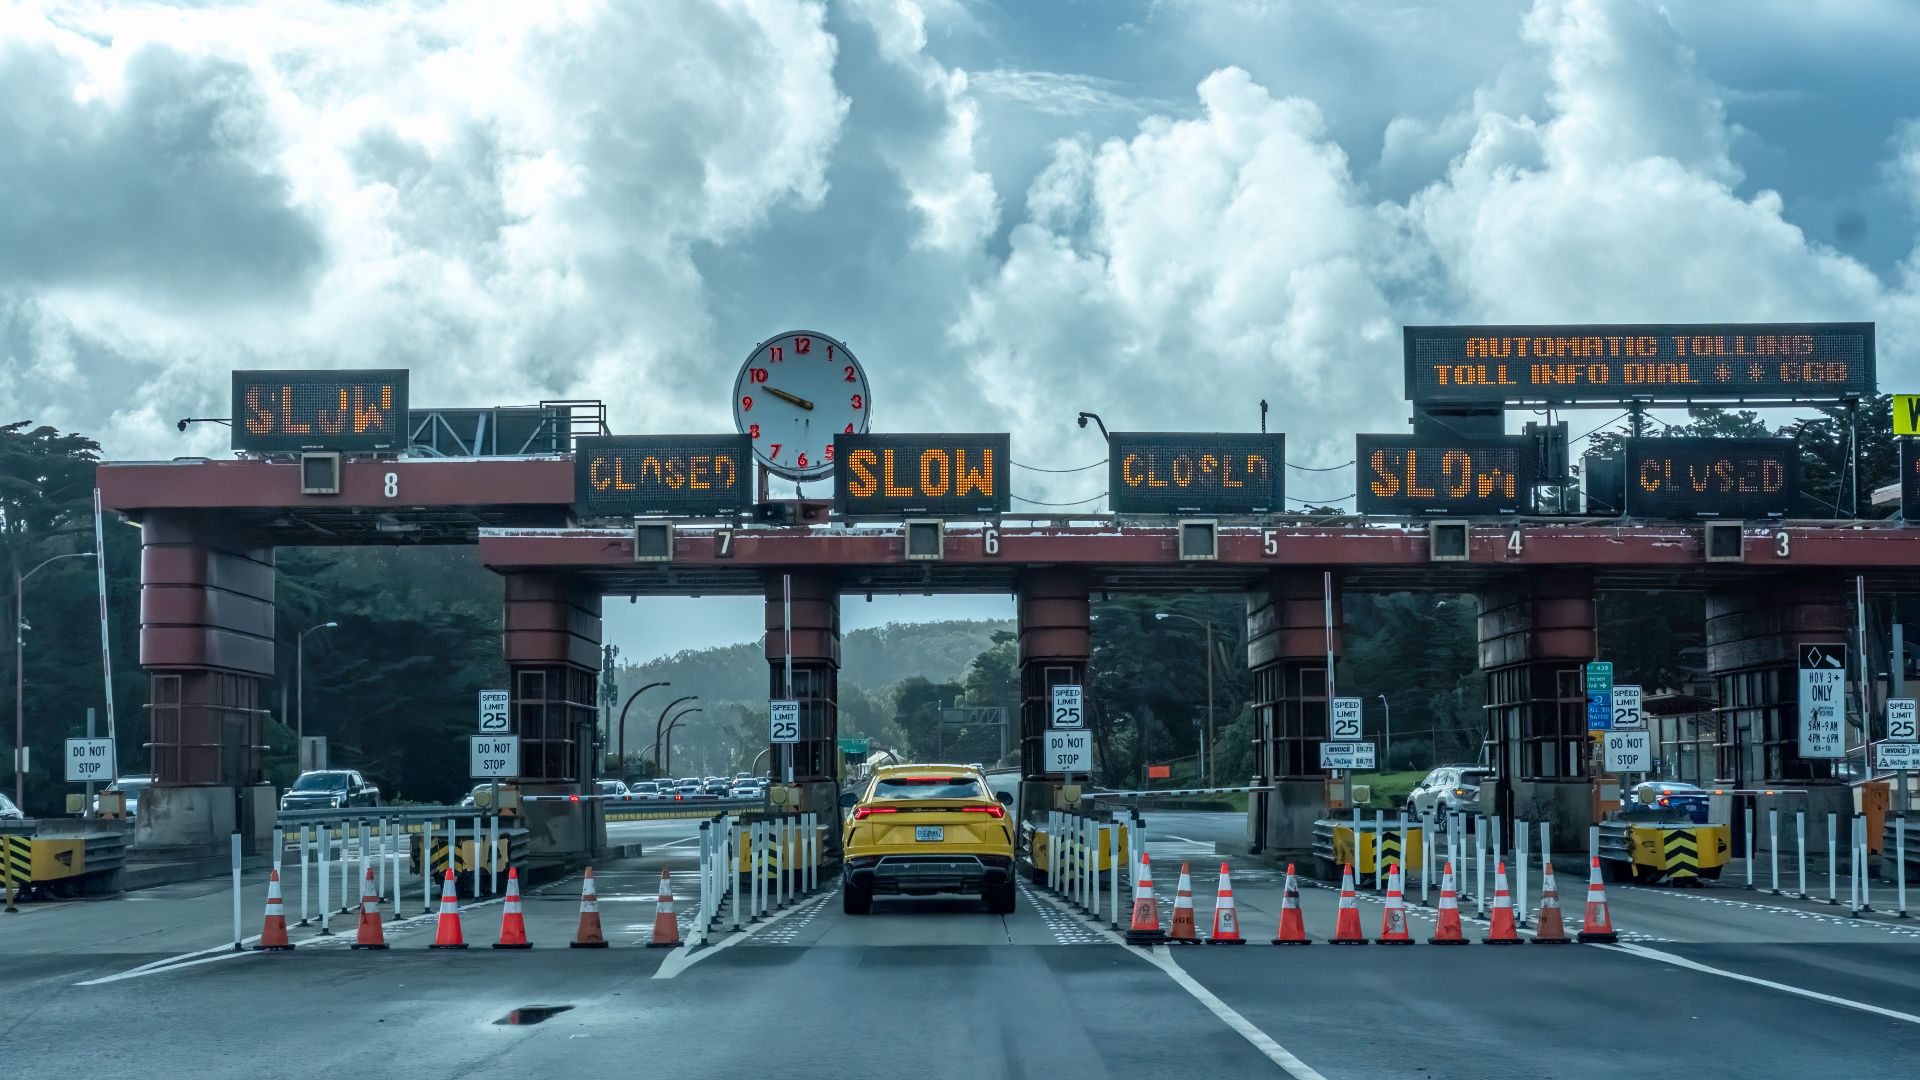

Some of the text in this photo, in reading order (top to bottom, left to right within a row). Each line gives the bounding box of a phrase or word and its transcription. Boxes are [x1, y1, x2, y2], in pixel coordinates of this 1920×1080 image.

[794, 337, 811, 354] 12
[827, 345, 834, 361] 1
[1466, 335, 1813, 357] AUTOMATIC TOLLING
[770, 347, 783, 362] 11
[749, 368, 768, 383] 10
[844, 366, 856, 383] 2
[1433, 365, 1517, 385] TOLL
[1531, 364, 1609, 384] INFO
[1623, 363, 1699, 383] DIAL
[742, 396, 753, 412] 9
[851, 394, 862, 409] 3
[749, 424, 760, 439] 8
[770, 444, 782, 460] 7
[825, 444, 834, 460] 5
[797, 453, 808, 468] 6
[849, 449, 993, 497] SLOW
[384, 472, 398, 498] 8
[718, 531, 731, 555] 7
[985, 529, 999, 554] 6
[1264, 530, 1278, 555] 5
[1507, 530, 1523, 555] 4
[1776, 532, 1789, 557] 3
[1809, 672, 1824, 683] HOV
[1055, 689, 1080, 697] SPEED
[1614, 689, 1639, 697] SPEED
[1812, 685, 1833, 701] ONLY
[484, 703, 505, 711] LIMIT
[1057, 698, 1078, 706] LIMIT
[1334, 701, 1360, 709] SPEED
[1889, 702, 1915, 710] SPEED
[482, 712, 507, 729] 25
[1056, 707, 1080, 724] 25
[1336, 710, 1357, 718] LIMIT
[1614, 707, 1639, 724] 25
[773, 722, 797, 739] 25
[1335, 719, 1359, 736] 25
[1890, 720, 1915, 737] 25
[73, 746, 106, 757] DO NOT
[478, 743, 511, 754] DO NOT
[1052, 738, 1084, 749] DO NOT
[1610, 738, 1643, 749] DO NOT
[79, 762, 101, 773] STOP
[484, 759, 506, 770] STOP
[1057, 754, 1079, 765] STOP
[1617, 754, 1639, 765] STOP
